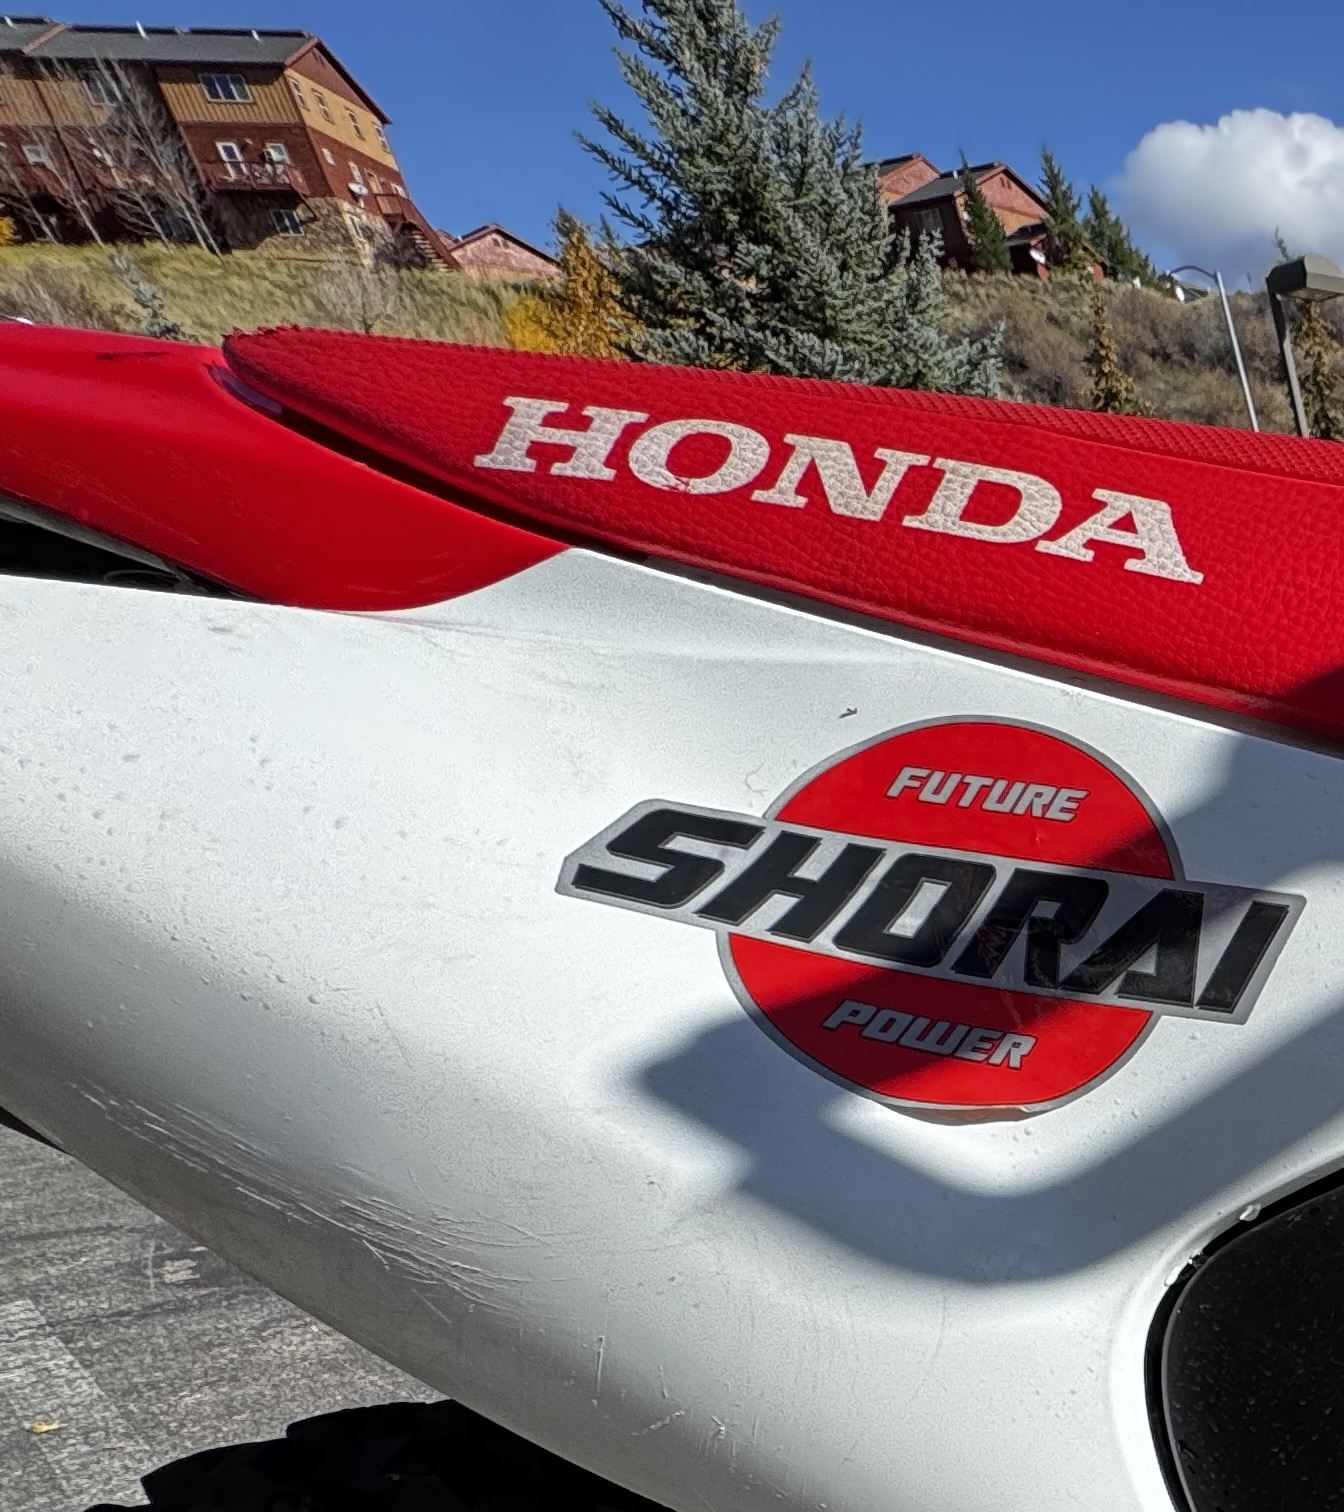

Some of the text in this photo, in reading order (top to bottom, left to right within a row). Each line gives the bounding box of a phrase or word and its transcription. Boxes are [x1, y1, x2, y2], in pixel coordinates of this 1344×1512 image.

[473, 395, 1204, 585] HONDA
[885, 764, 1089, 823] FUTURE
[570, 808, 1291, 1014] SHORAI
[822, 999, 1037, 1070] POWER
